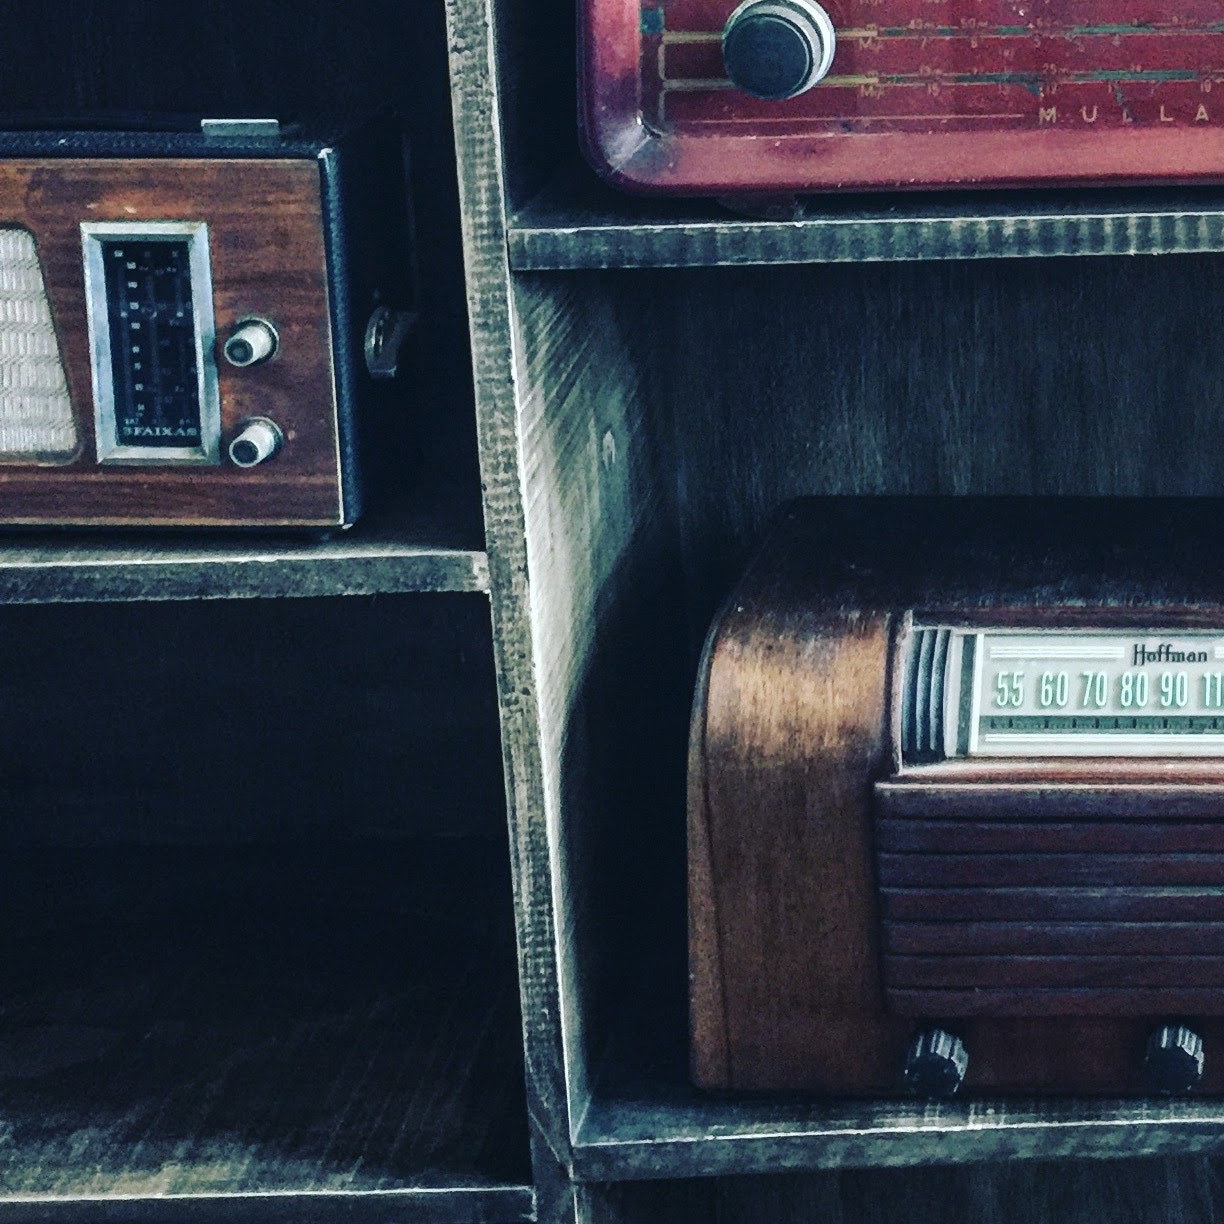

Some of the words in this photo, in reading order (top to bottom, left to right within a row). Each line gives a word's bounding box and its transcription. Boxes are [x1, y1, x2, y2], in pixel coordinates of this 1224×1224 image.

[1132, 643, 1209, 667] Hoffman
[996, 672, 1025, 707] 55
[1040, 672, 1069, 707] 60
[1081, 672, 1108, 707] 70
[1120, 672, 1150, 707] 80
[1159, 672, 1189, 707] 90
